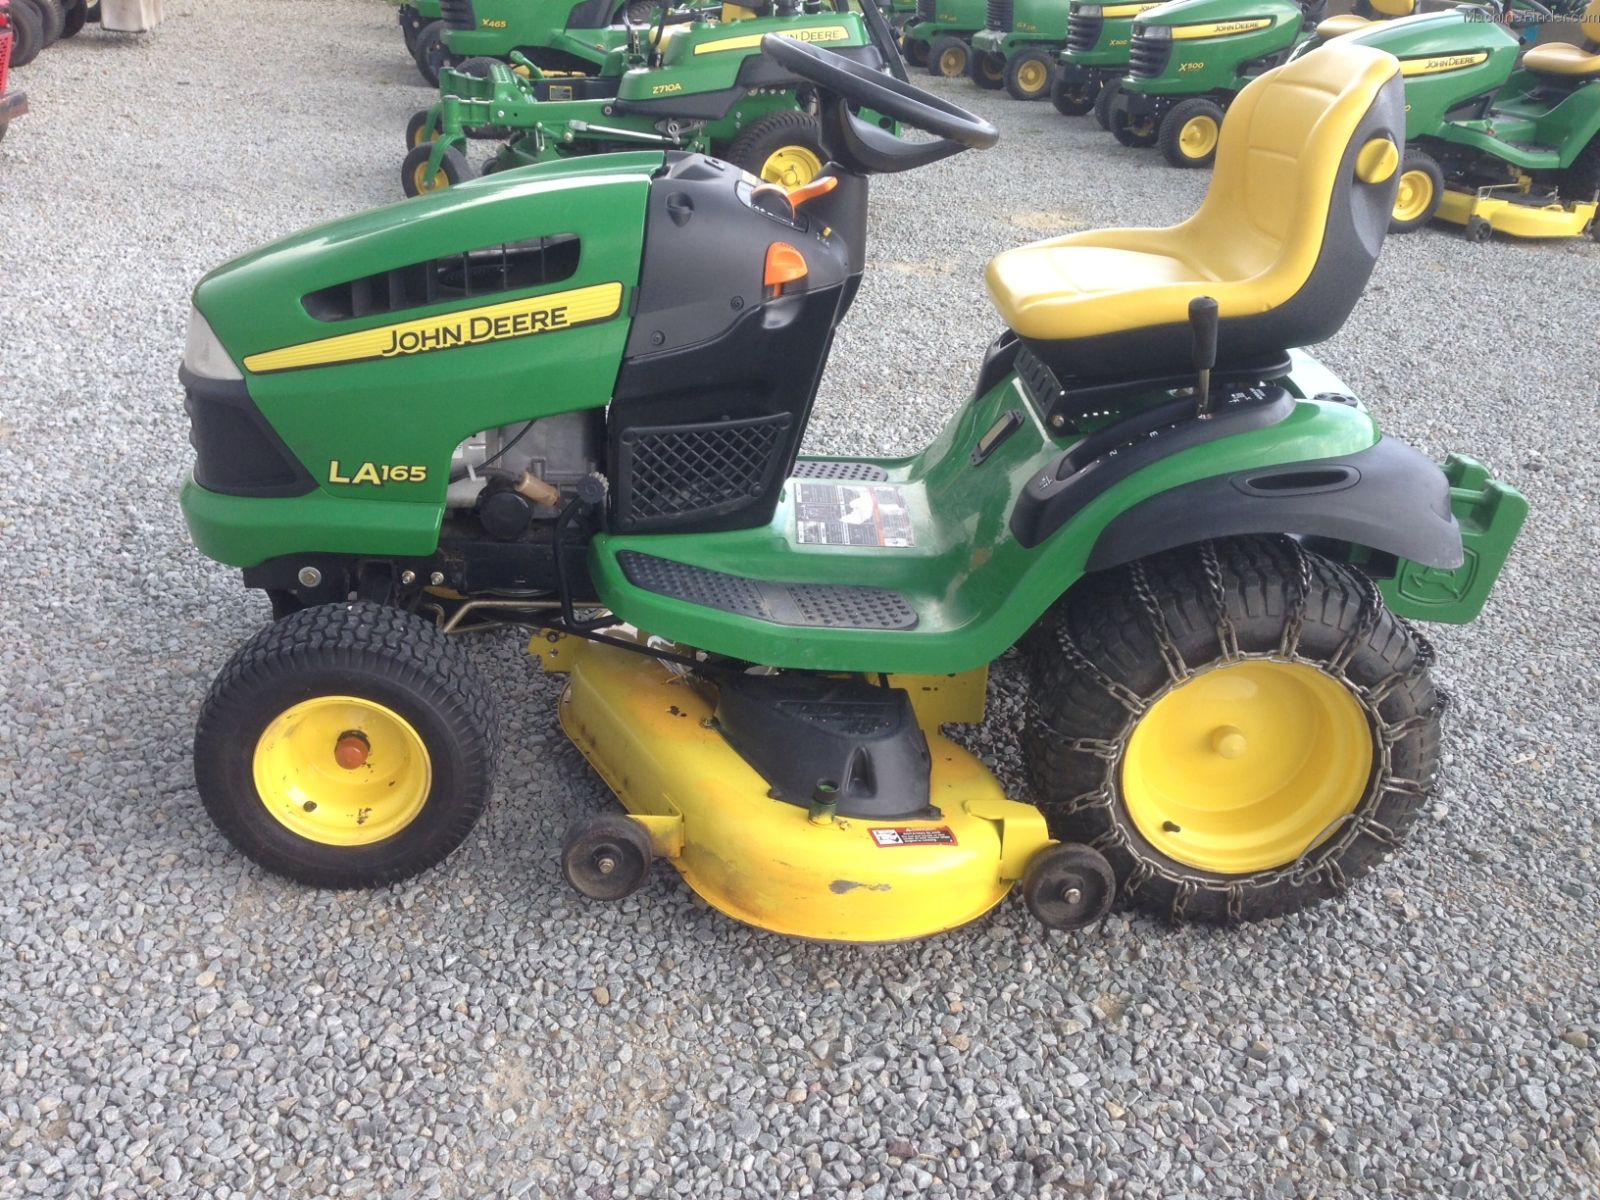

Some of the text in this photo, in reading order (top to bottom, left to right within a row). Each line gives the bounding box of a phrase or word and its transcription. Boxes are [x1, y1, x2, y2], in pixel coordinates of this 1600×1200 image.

[482, 17, 507, 28] X465
[1234, 21, 1258, 31] DEERE
[801, 30, 840, 41] DEERE
[1424, 56, 1475, 69] JOHN DEERE
[652, 82, 682, 95] Z710A
[382, 306, 568, 354] JOHN DEERE
[328, 460, 427, 485] LA165
